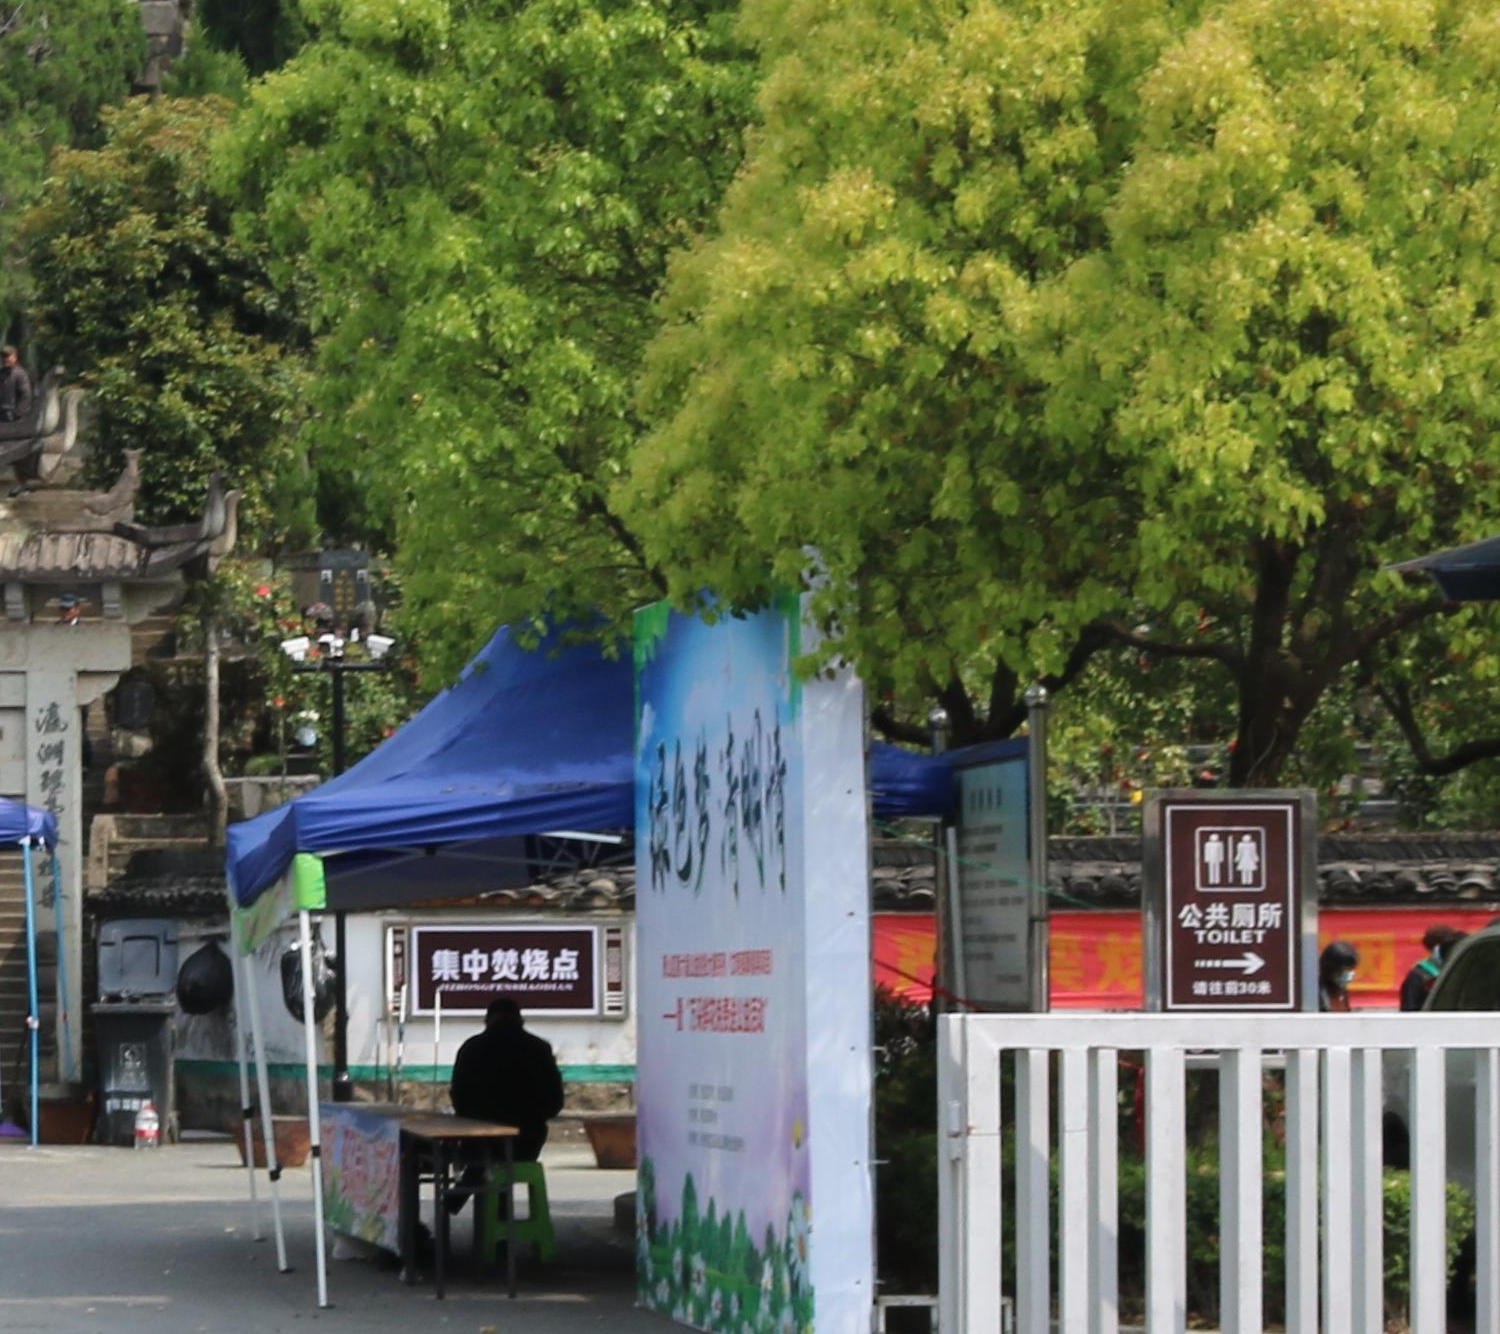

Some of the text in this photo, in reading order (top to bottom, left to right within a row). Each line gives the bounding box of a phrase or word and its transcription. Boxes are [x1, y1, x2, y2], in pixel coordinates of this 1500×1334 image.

[1177, 902, 1284, 929] 公共厕所
[1194, 929, 1267, 944] TOILET
[431, 948, 580, 982] 集中焚烧点
[1192, 980, 1272, 995] 请往前30米
